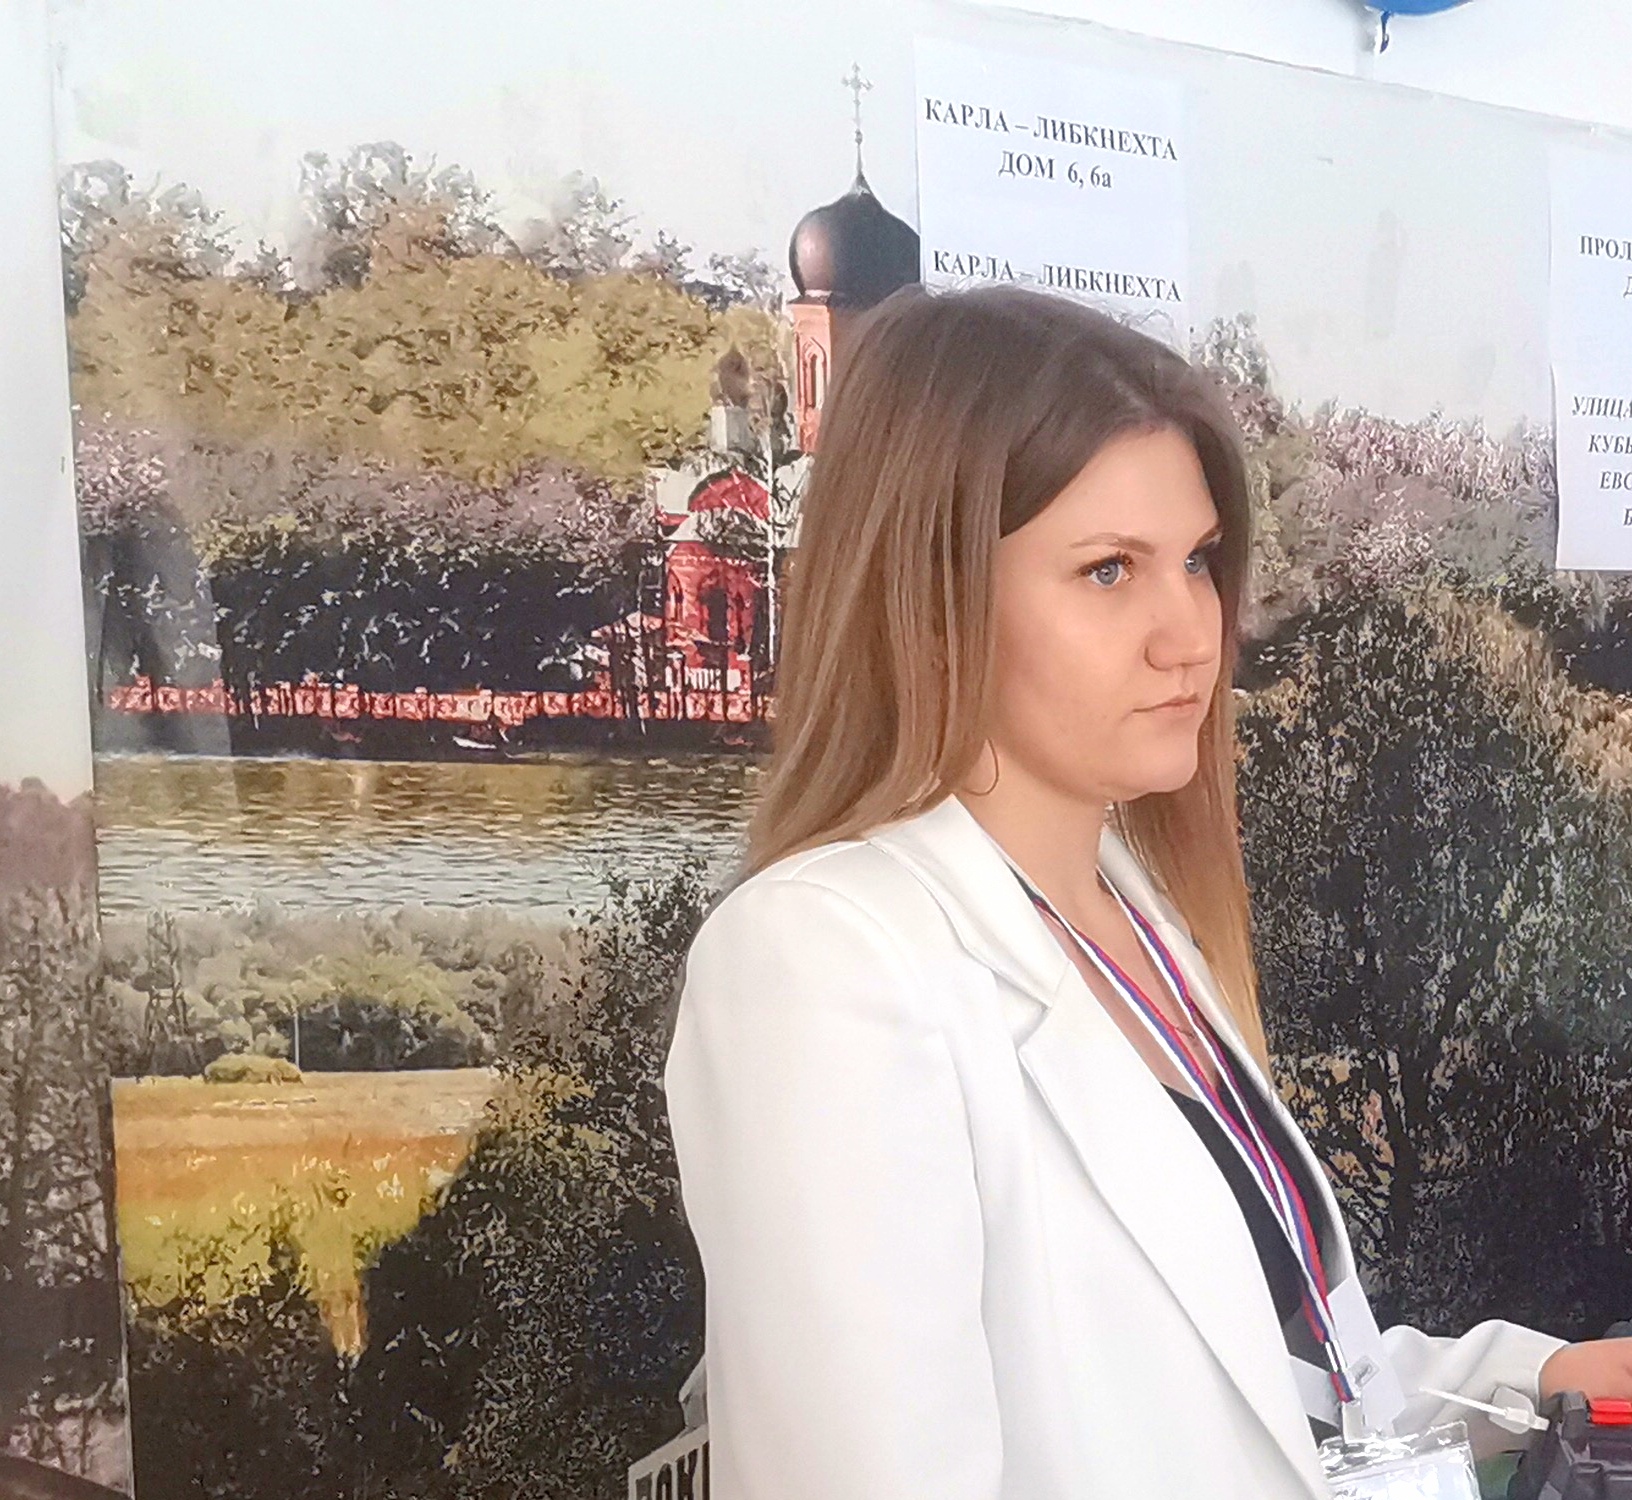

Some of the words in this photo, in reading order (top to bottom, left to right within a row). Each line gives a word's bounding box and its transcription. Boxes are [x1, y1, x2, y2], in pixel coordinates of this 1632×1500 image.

[925, 98, 1010, 133] КАРЛА
[1033, 115, 1178, 161] ЛИБКНЕХТА
[998, 151, 1055, 180] ДОМ
[1067, 161, 1084, 188] 6,
[1090, 165, 1112, 188] 6а
[934, 250, 1014, 281] КАРЛА
[1038, 264, 1182, 302] ЛИБКНЕХТА
